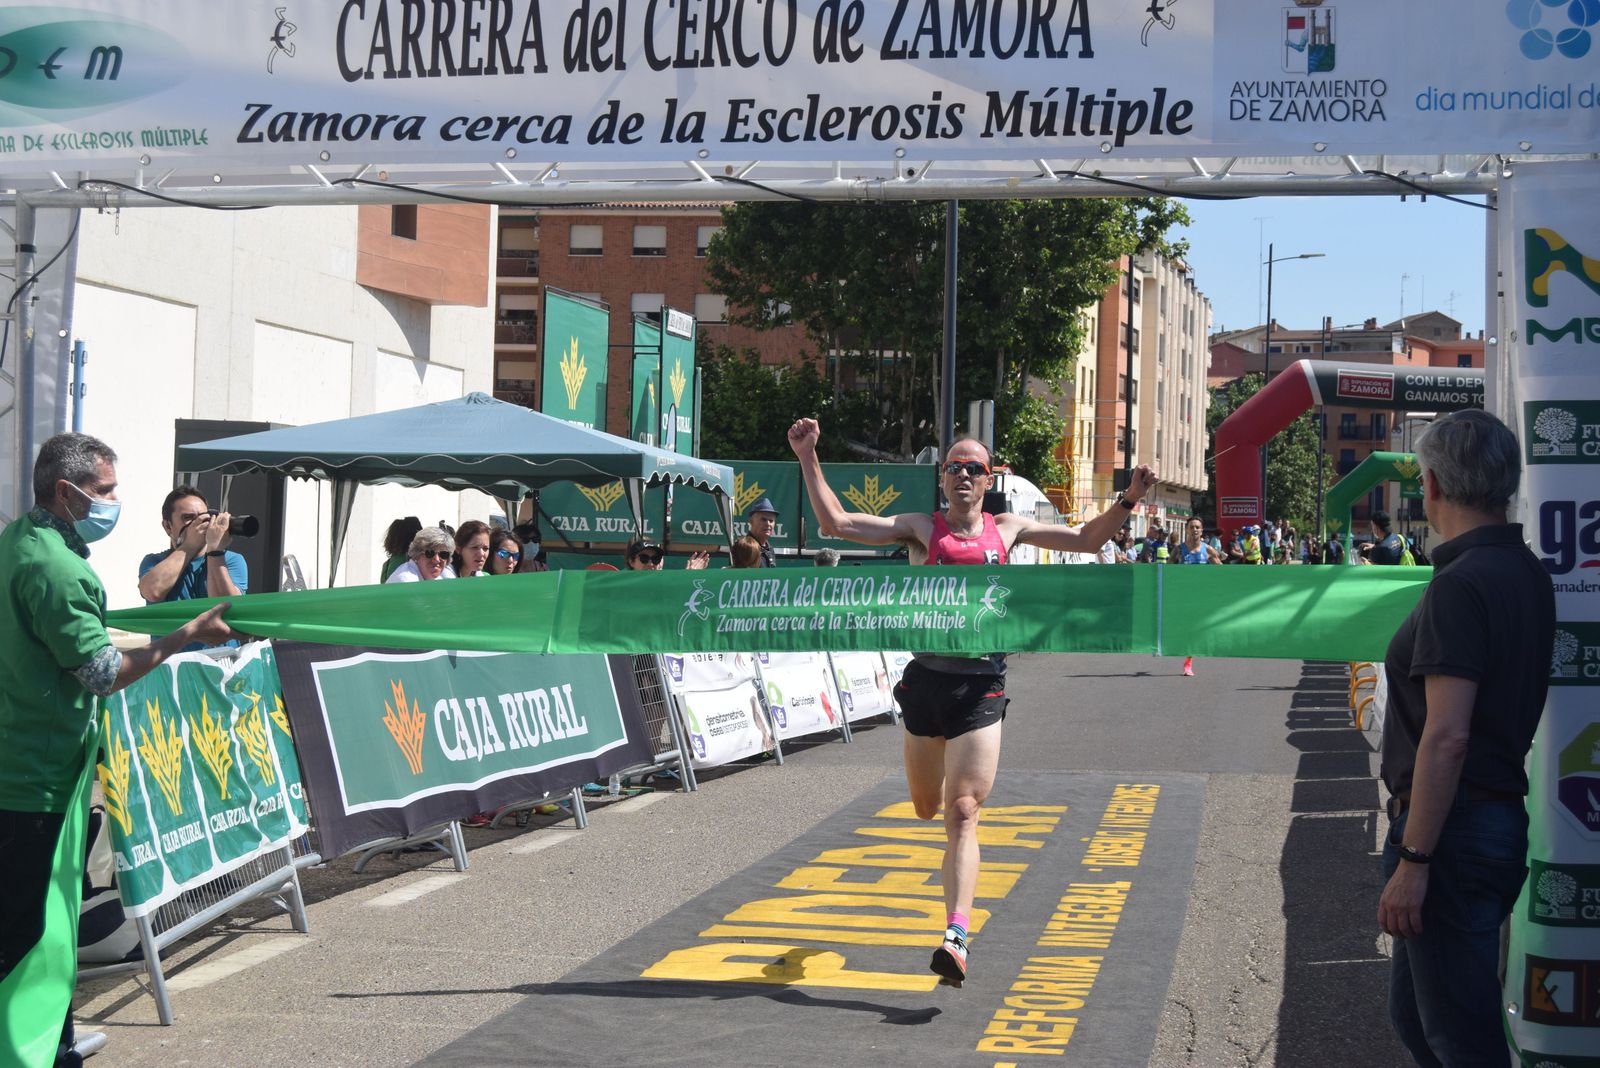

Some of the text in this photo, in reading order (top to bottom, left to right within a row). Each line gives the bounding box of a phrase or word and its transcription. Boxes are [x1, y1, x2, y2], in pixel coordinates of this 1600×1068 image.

[336, 0, 1095, 82] CARRERA del CERCO de ZAMORA
[1230, 79, 1387, 98] AYUNTAMIENTO
[1462, 83, 1571, 111] mundial
[237, 86, 1194, 147] Zamora cerca de la Esclerosis Múltiple
[1229, 99, 1386, 122] DE ZAMORA
[23, 134, 44, 151] DE
[51, 130, 134, 151] ESCLEROSIS
[141, 126, 209, 148] MÚLTIPLE
[1350, 384, 1391, 395] ZAMORA
[1405, 374, 1434, 388] CON
[1437, 376, 1453, 388] EL
[1404, 390, 1468, 405] GANAMOS
[551, 516, 590, 532] CAJA
[681, 520, 724, 536] CAJA
[718, 575, 968, 609] CARRERA del CERCO de ZAMORA
[1551, 579, 1600, 593] anader
[716, 610, 966, 633] Zamora cerca de la Esclerosis Múltiple
[434, 683, 589, 762] CAJA RURAL
[1035, 881, 1132, 949] INTEGRAL
[975, 955, 1105, 1055] REFORMA
